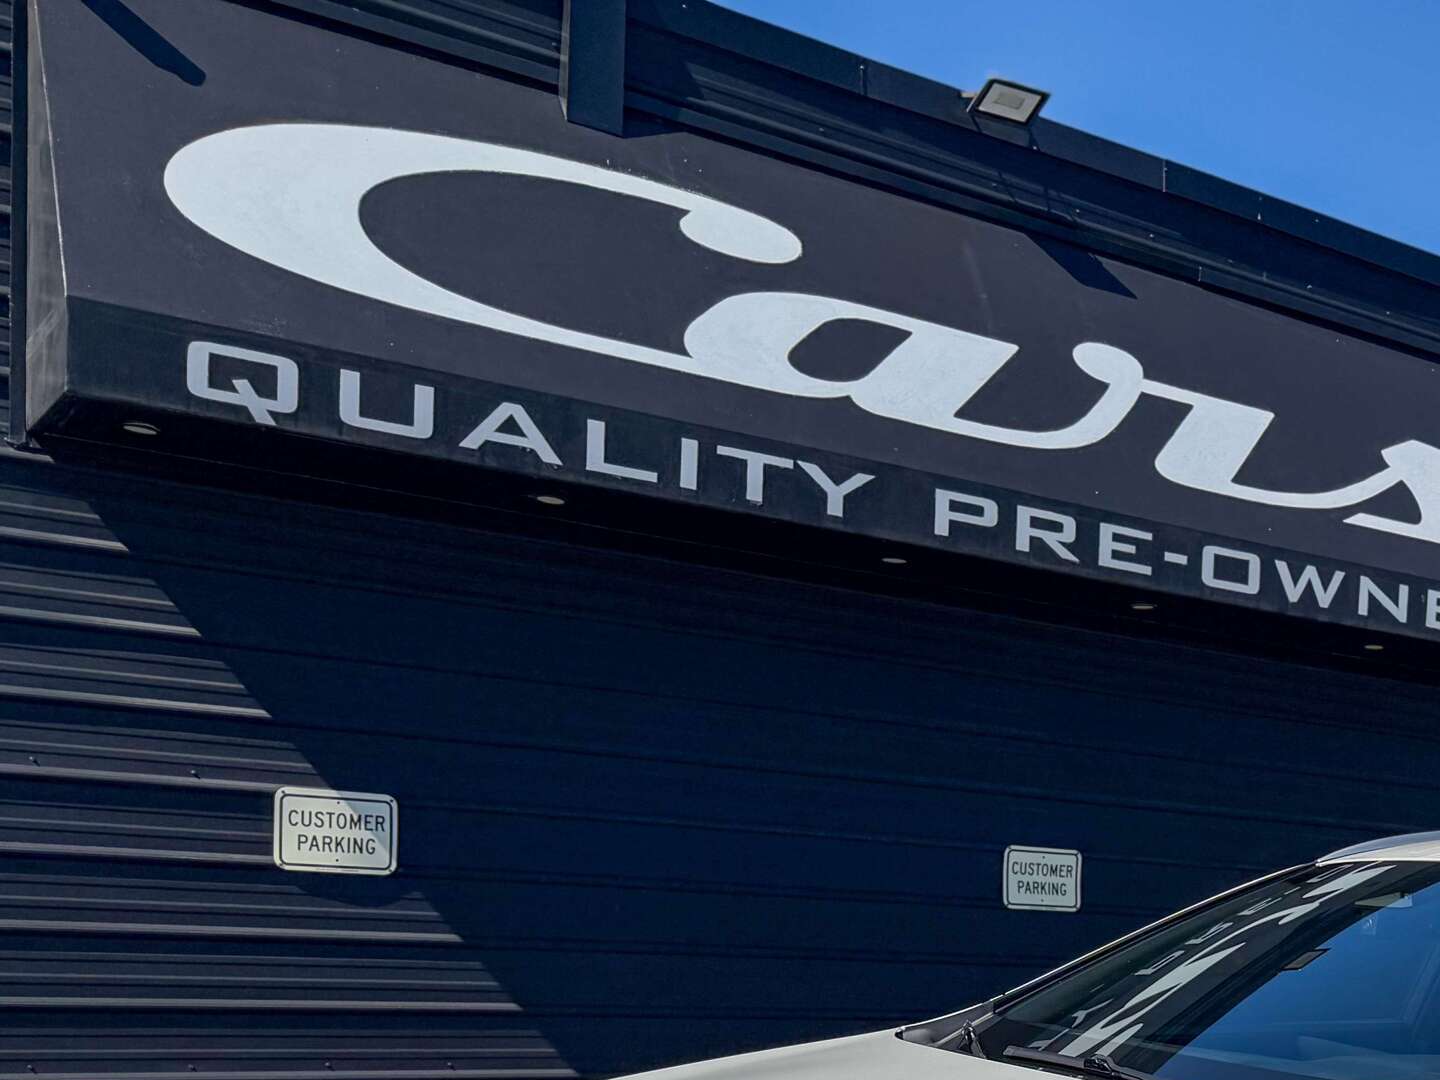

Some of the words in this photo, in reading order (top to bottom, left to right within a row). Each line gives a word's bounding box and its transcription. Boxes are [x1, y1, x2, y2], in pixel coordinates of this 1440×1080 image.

[187, 341, 875, 518] QUALITY
[288, 808, 386, 832] CUSTOMER
[297, 833, 377, 856] PARKING
[1011, 860, 1074, 879] CUSTOMER
[1016, 880, 1068, 897] PARKING
